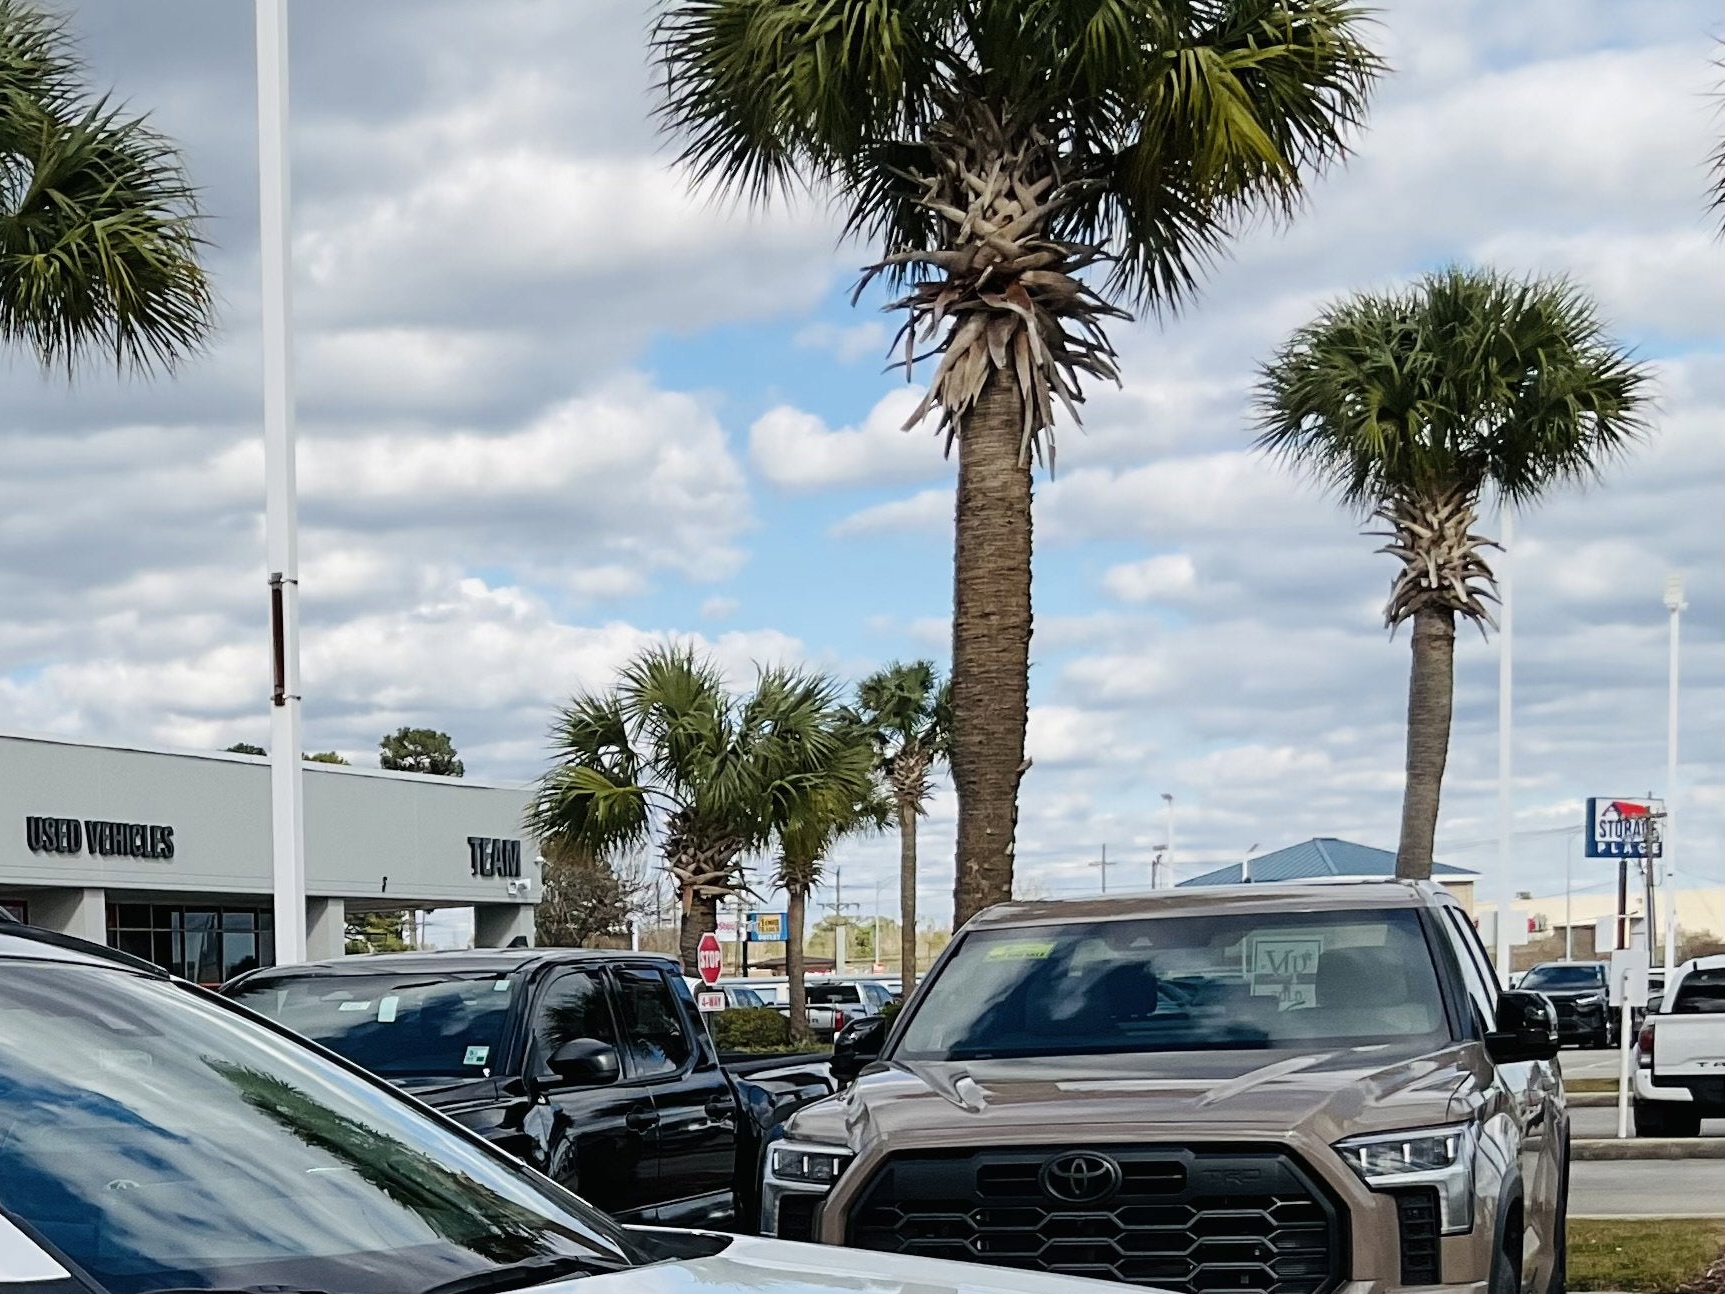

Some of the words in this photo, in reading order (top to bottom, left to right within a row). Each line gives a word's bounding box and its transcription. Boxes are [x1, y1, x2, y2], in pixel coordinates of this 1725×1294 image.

[26, 816, 82, 853] USED
[84, 820, 174, 859] VEHICLES
[467, 836, 521, 877] TEAM
[1597, 841, 1660, 854] PLACE
[700, 950, 721, 969] STOP
[701, 996, 721, 1007] 4-WAY
